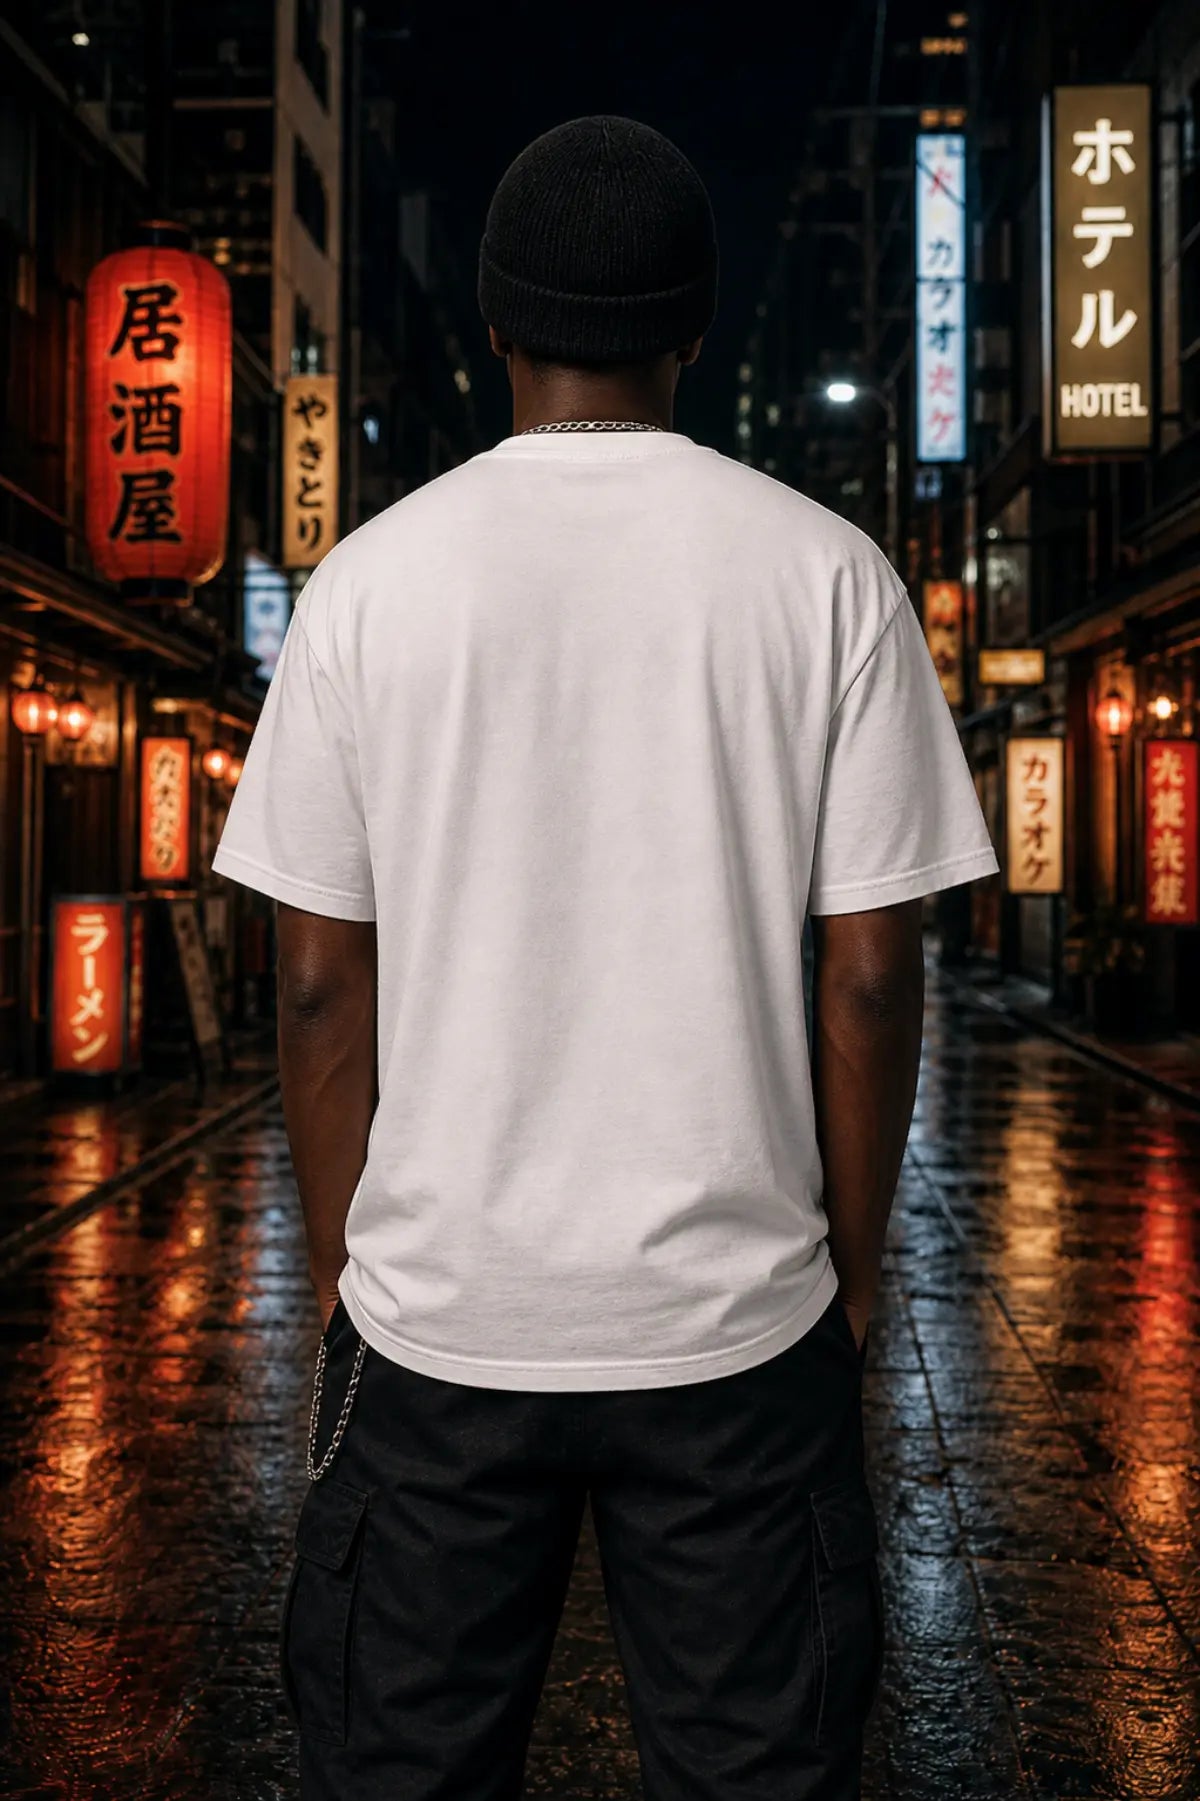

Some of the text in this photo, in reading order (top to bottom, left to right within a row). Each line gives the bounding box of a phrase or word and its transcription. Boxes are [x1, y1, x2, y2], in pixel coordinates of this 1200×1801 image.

[1071, 118, 1138, 349] ホテル
[109, 284, 183, 544] 居酒屋
[292, 393, 327, 548] やきとり
[1060, 383, 1149, 418] HOTEL
[1022, 753, 1052, 886] カラオケ
[70, 913, 109, 1063] ラーメン
